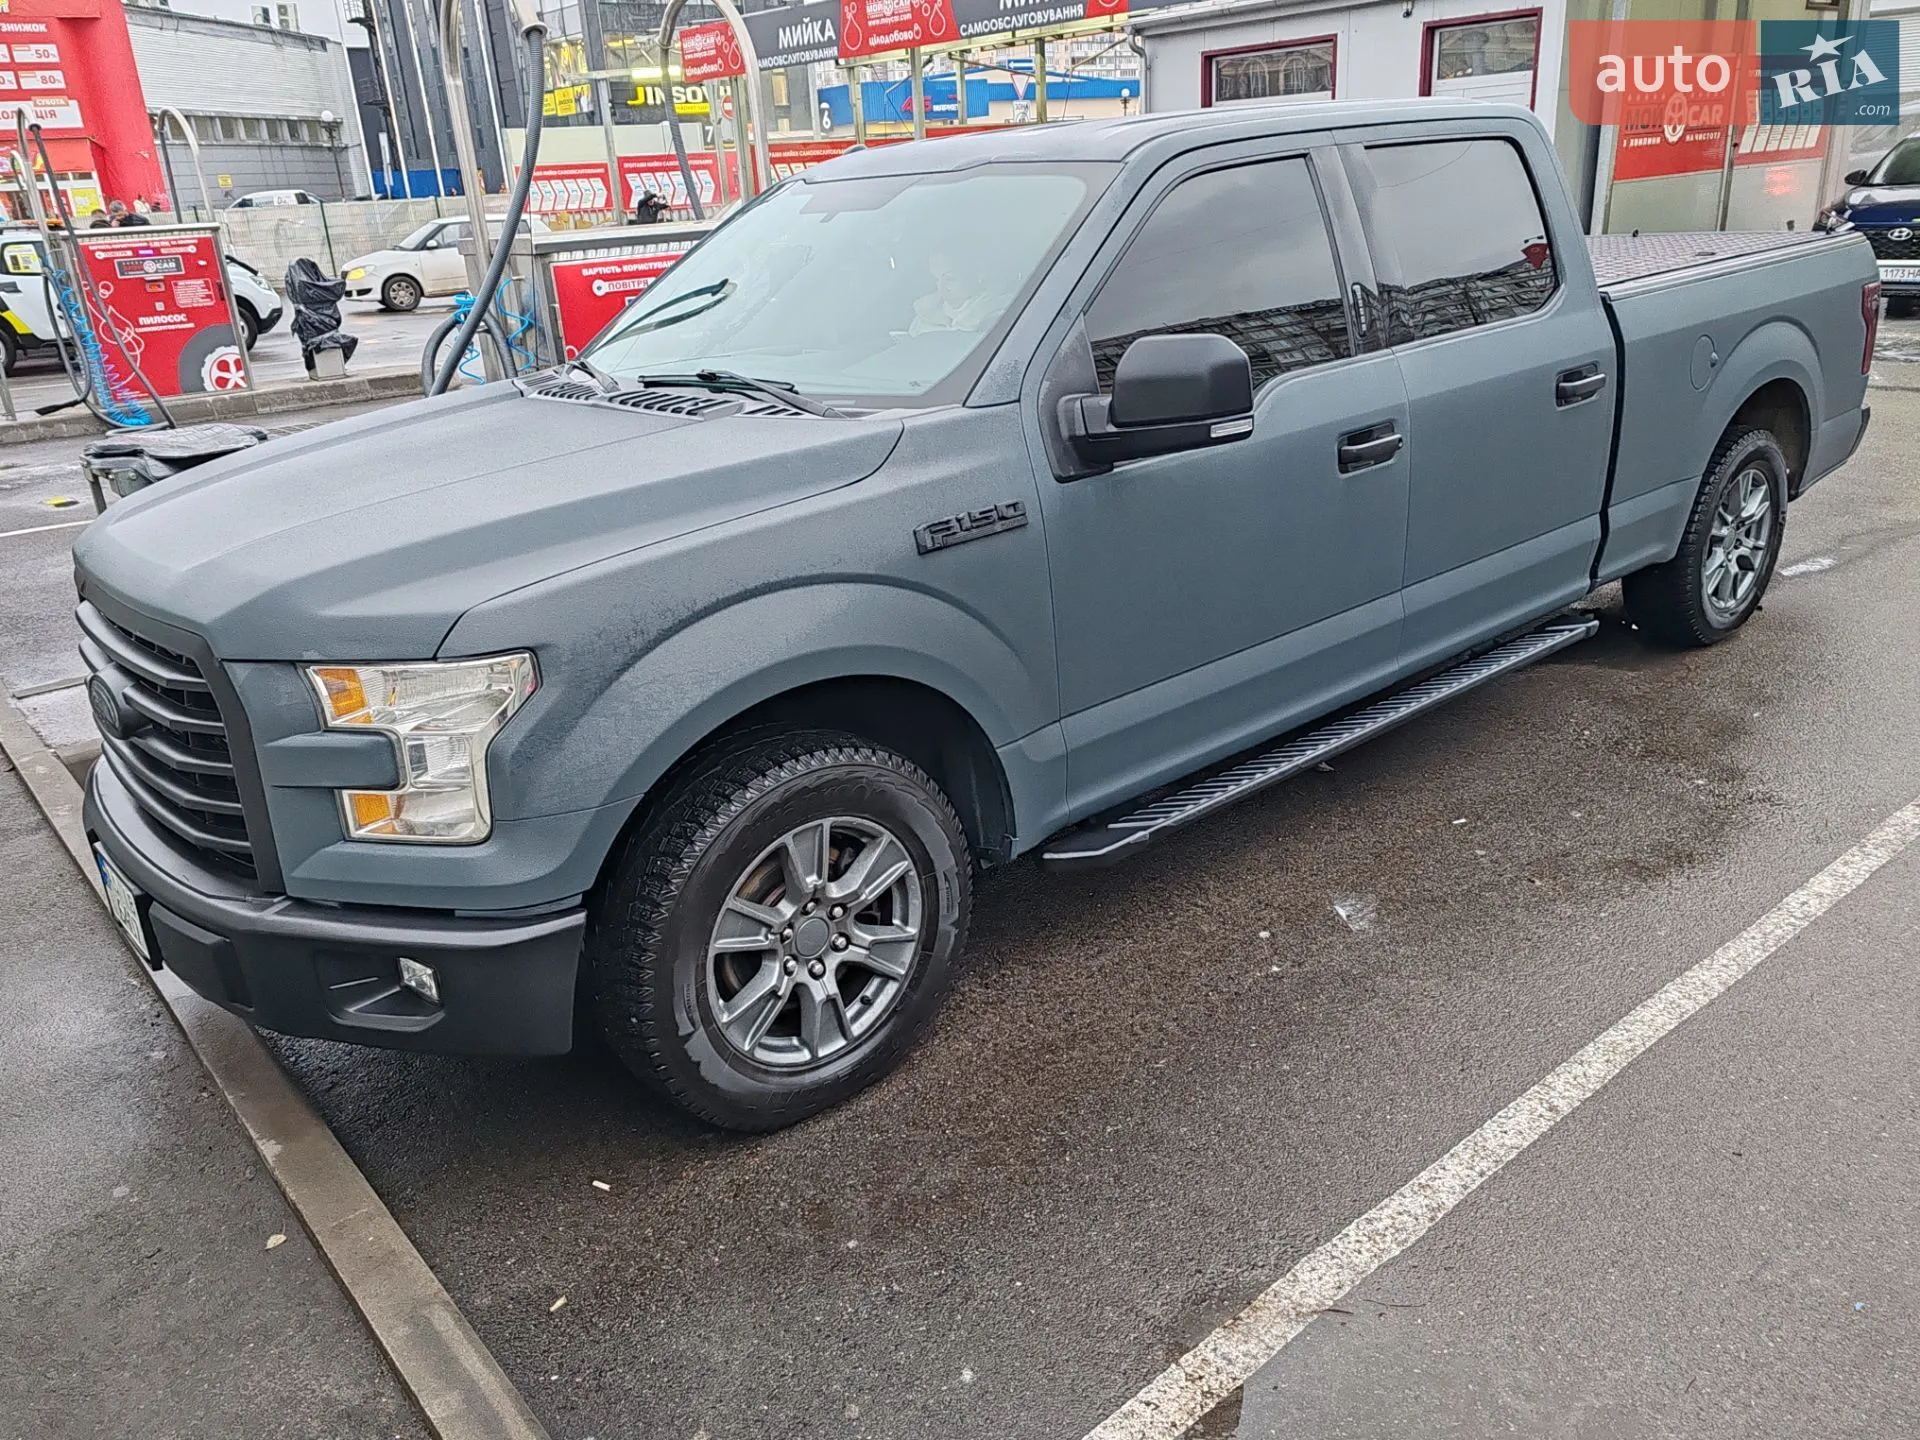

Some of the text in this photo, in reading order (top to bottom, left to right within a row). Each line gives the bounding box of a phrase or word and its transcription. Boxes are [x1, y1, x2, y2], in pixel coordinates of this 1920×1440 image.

[960, 4, 1084, 36] САМООБСЛУГОВУВАННЯ
[779, 16, 836, 50] МИЙКА
[758, 46, 839, 69] АМООБСЛУГОВУВАННЯ
[822, 110, 832, 129] 6
[704, 125, 714, 143] 7
[1884, 268, 1906, 278] 1173
[608, 279, 649, 291] ПОВІТРЯ
[138, 313, 188, 326] ПИЛОСОС
